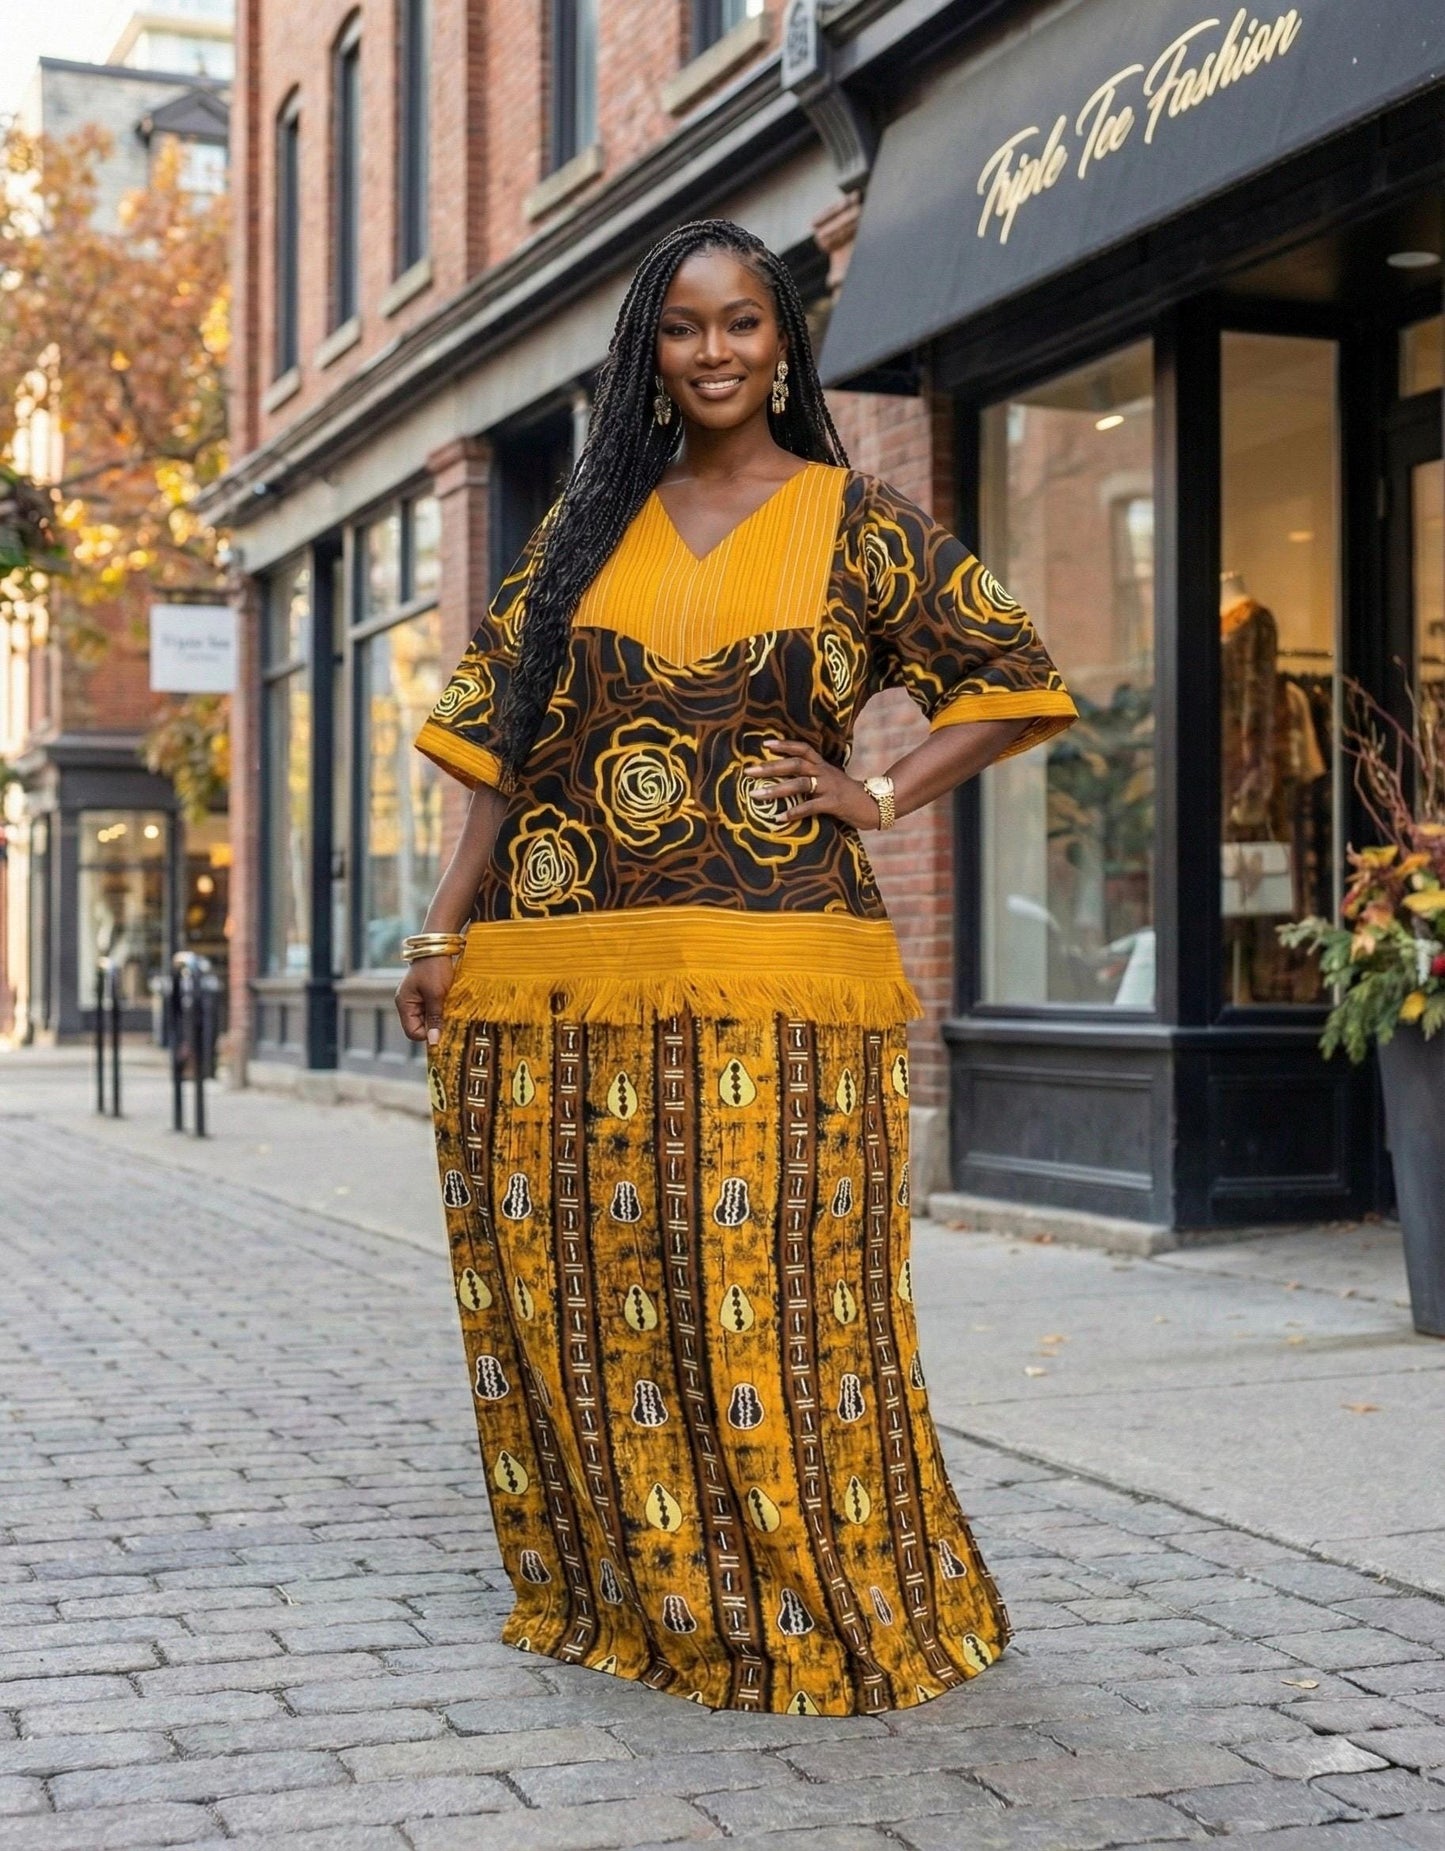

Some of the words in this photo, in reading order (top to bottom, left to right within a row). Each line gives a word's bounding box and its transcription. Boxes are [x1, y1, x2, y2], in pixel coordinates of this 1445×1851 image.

[977, 115, 1068, 245] Triple
[1075, 63, 1145, 180] Tee
[1142, 8, 1302, 144] Fashion
